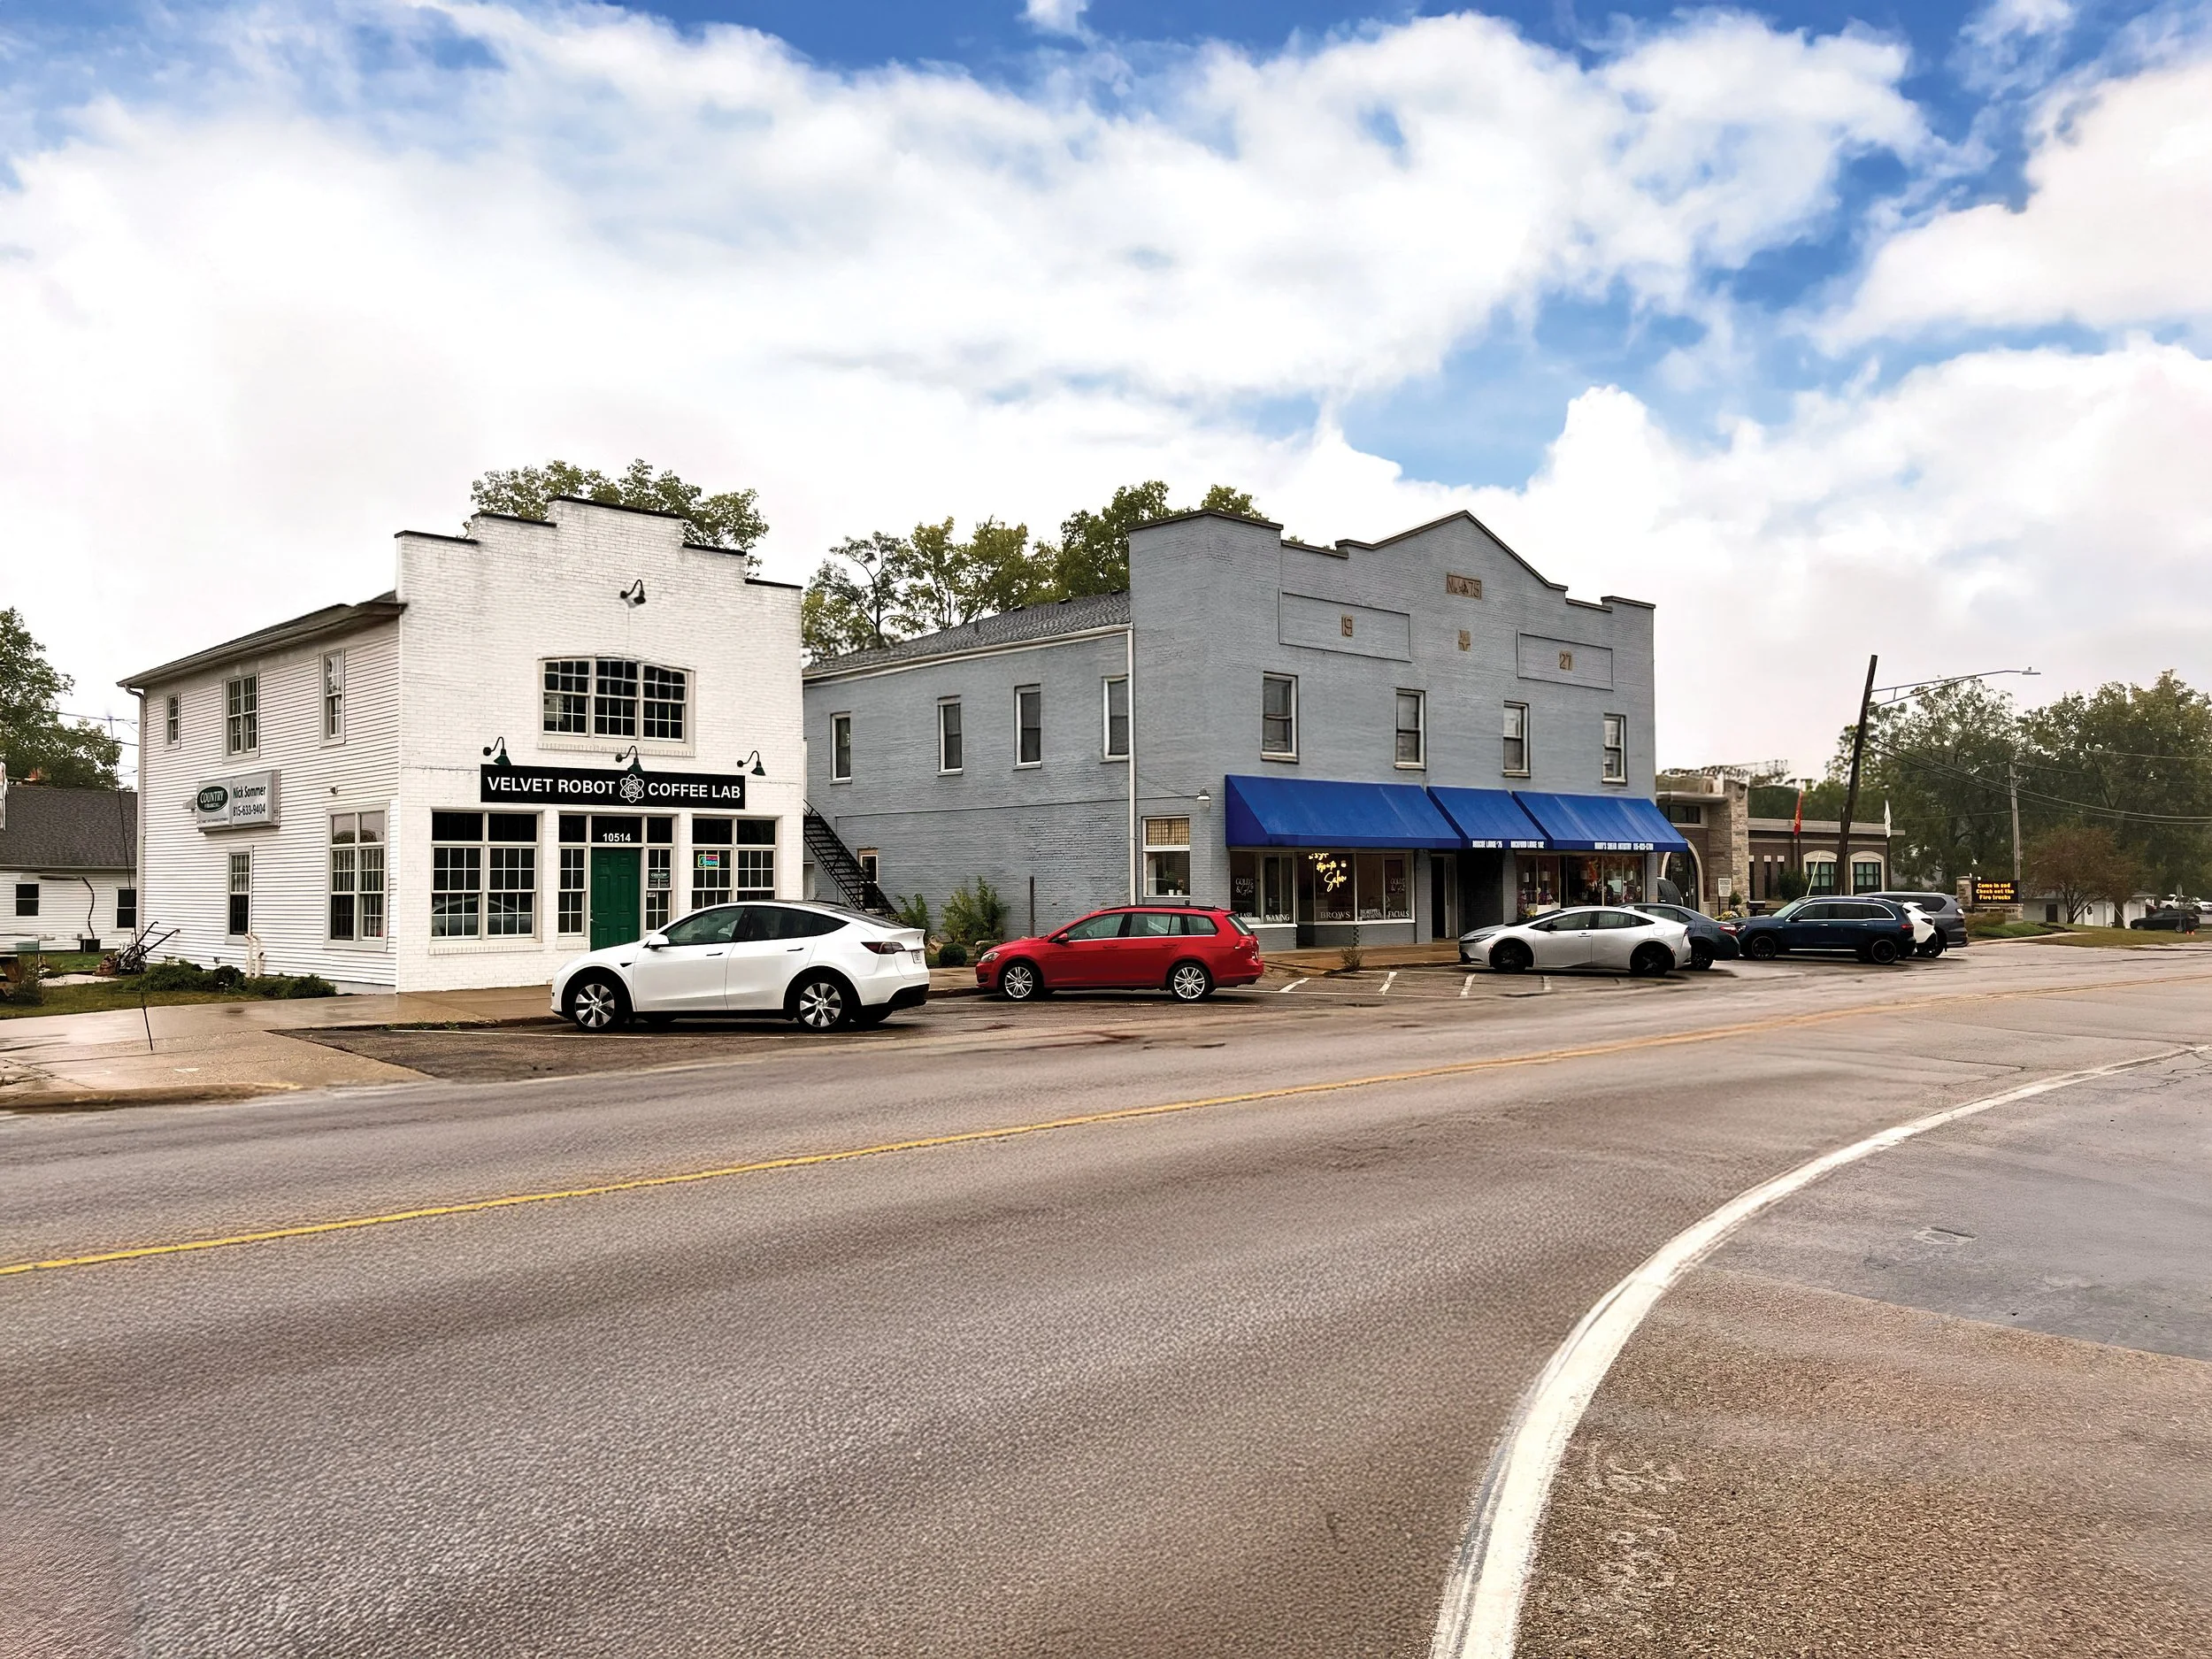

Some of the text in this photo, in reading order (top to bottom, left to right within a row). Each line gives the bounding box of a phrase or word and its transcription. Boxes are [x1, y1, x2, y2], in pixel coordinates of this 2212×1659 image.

[1341, 616, 1353, 637] 19
[1559, 653, 1572, 670] 27
[233, 786, 266, 799] Nick Sommer
[487, 776, 741, 798] VELVET ROBOT COFFEE LAB
[200, 789, 225, 803] COUNTRY
[603, 833, 632, 842] 10514
